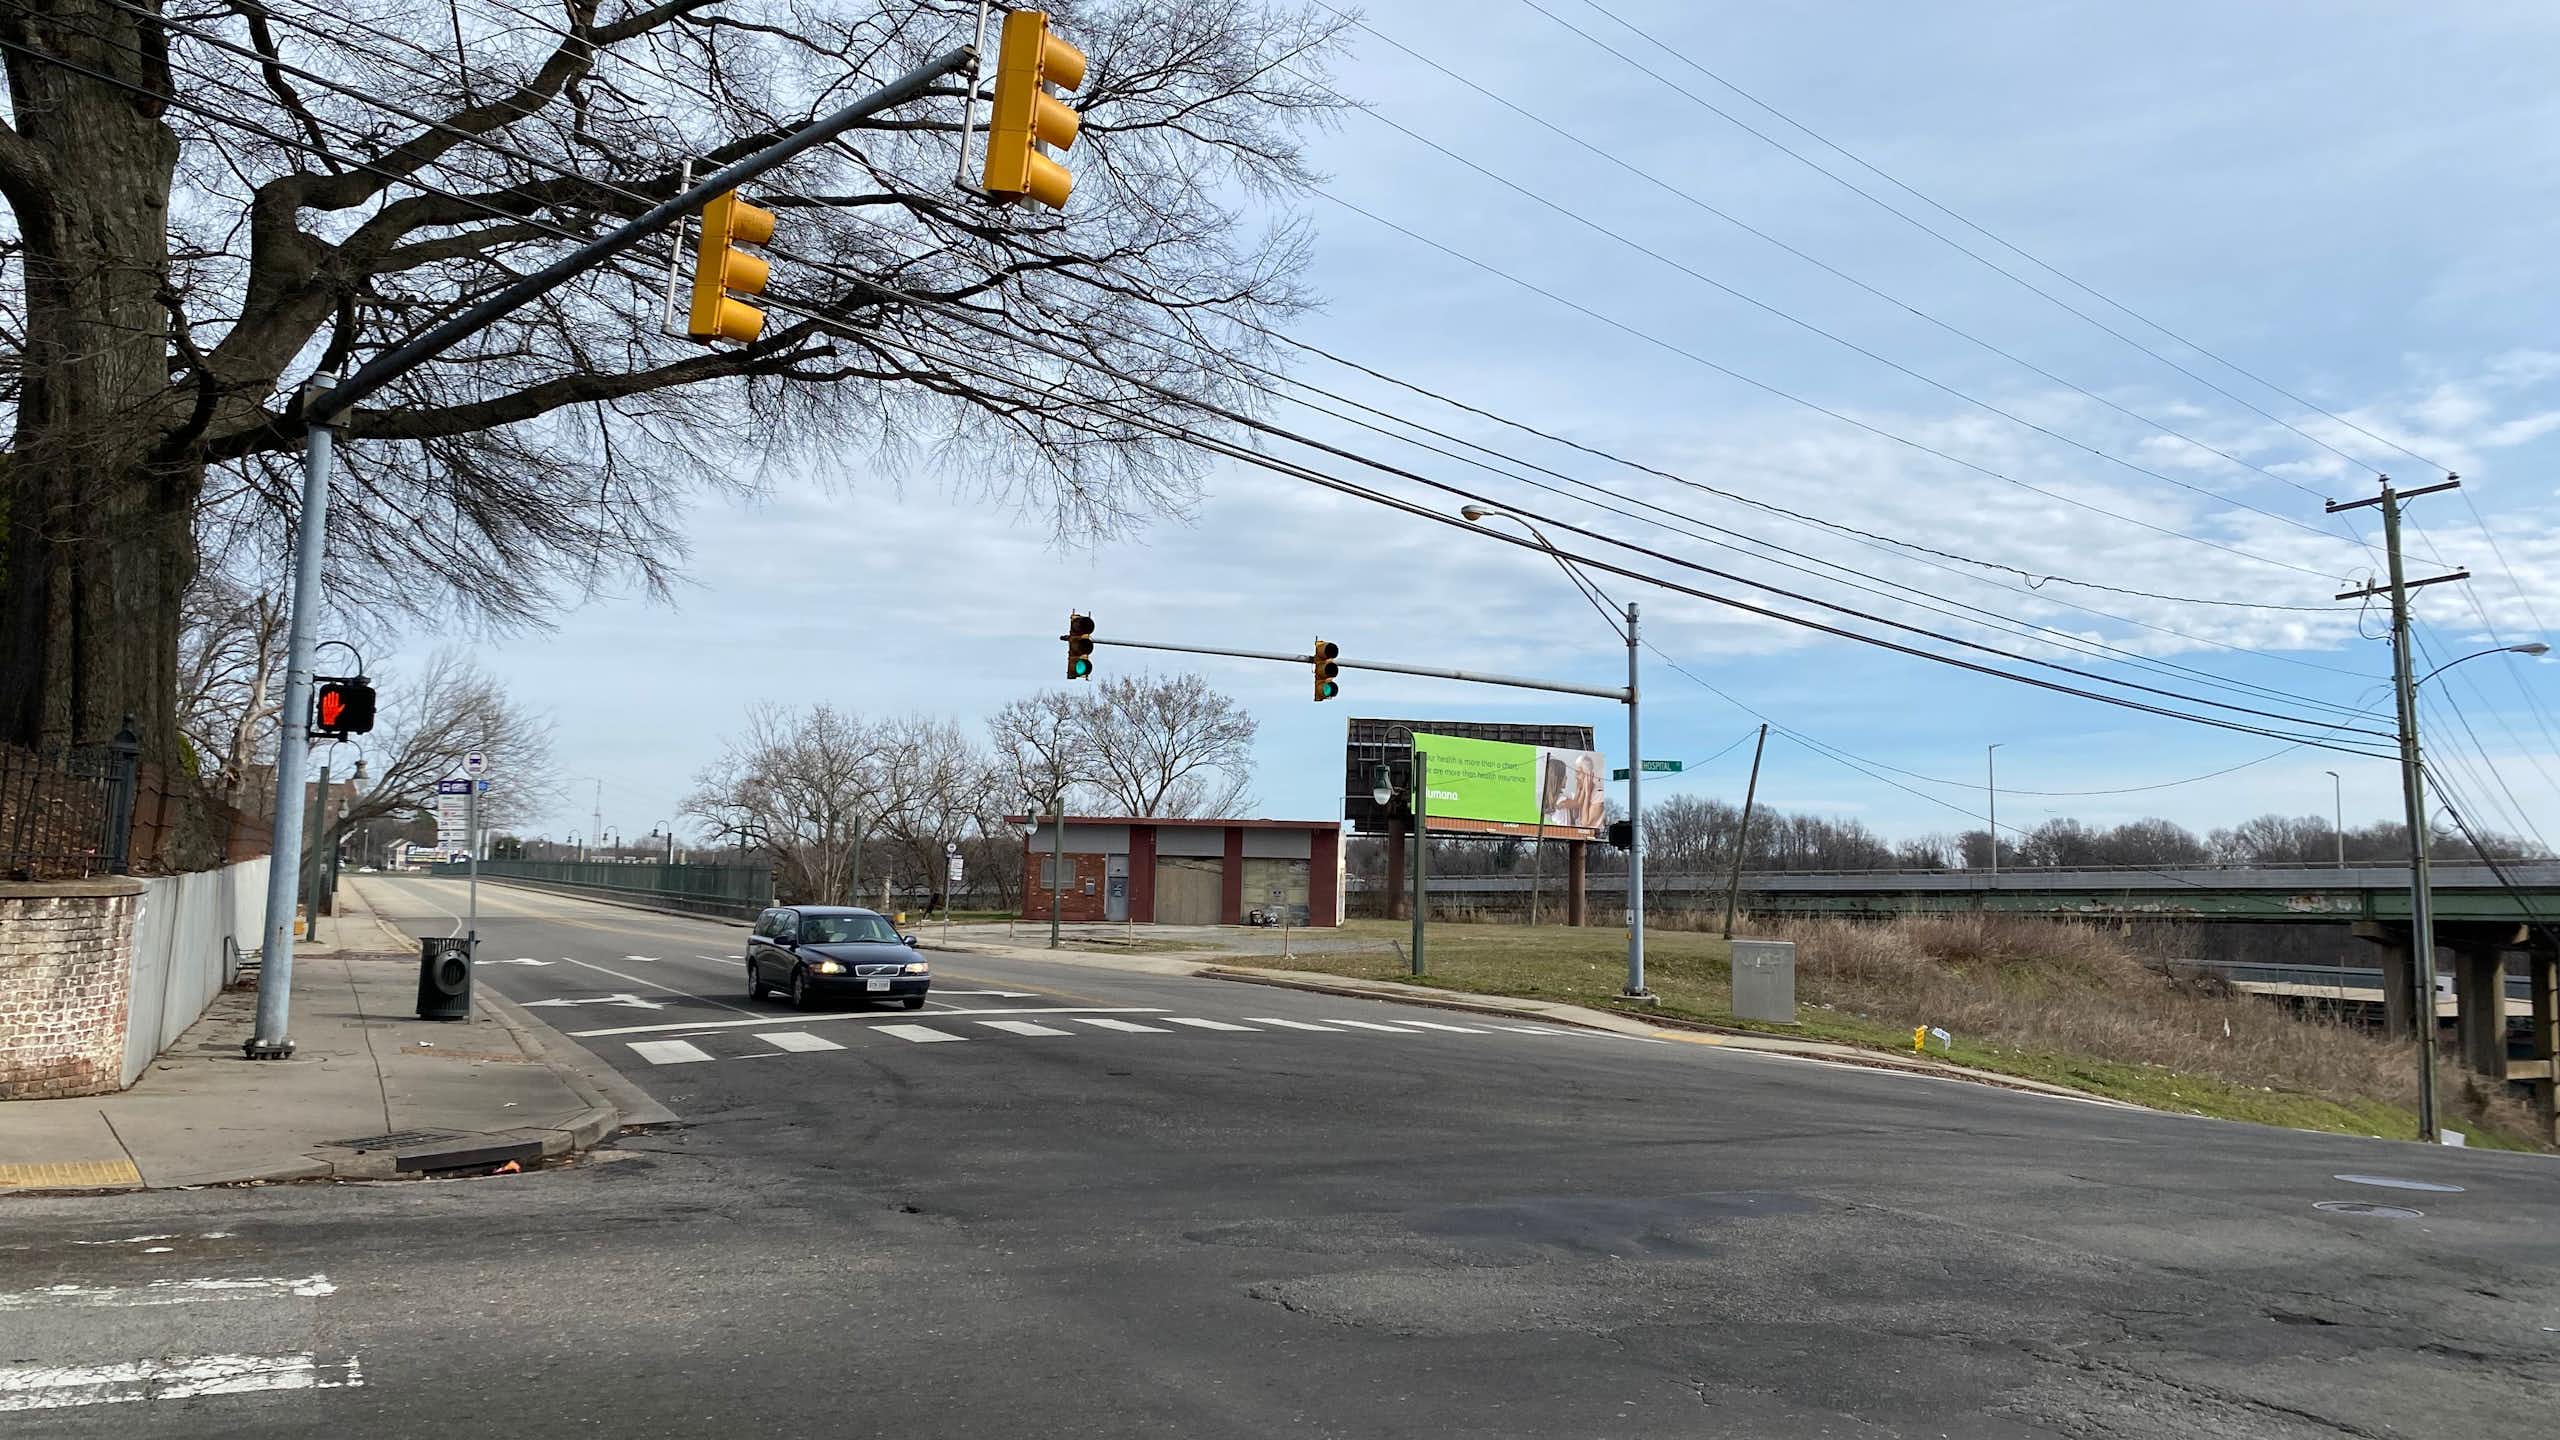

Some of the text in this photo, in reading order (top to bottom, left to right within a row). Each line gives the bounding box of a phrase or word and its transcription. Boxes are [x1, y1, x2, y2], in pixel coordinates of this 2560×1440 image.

[1437, 754, 1457, 764] health
[1464, 759, 1481, 767] more
[1482, 760, 1496, 768] than
[1643, 761, 1672, 771] HOSPITAL
[1462, 770, 1476, 778] than
[1477, 771, 1497, 780] health
